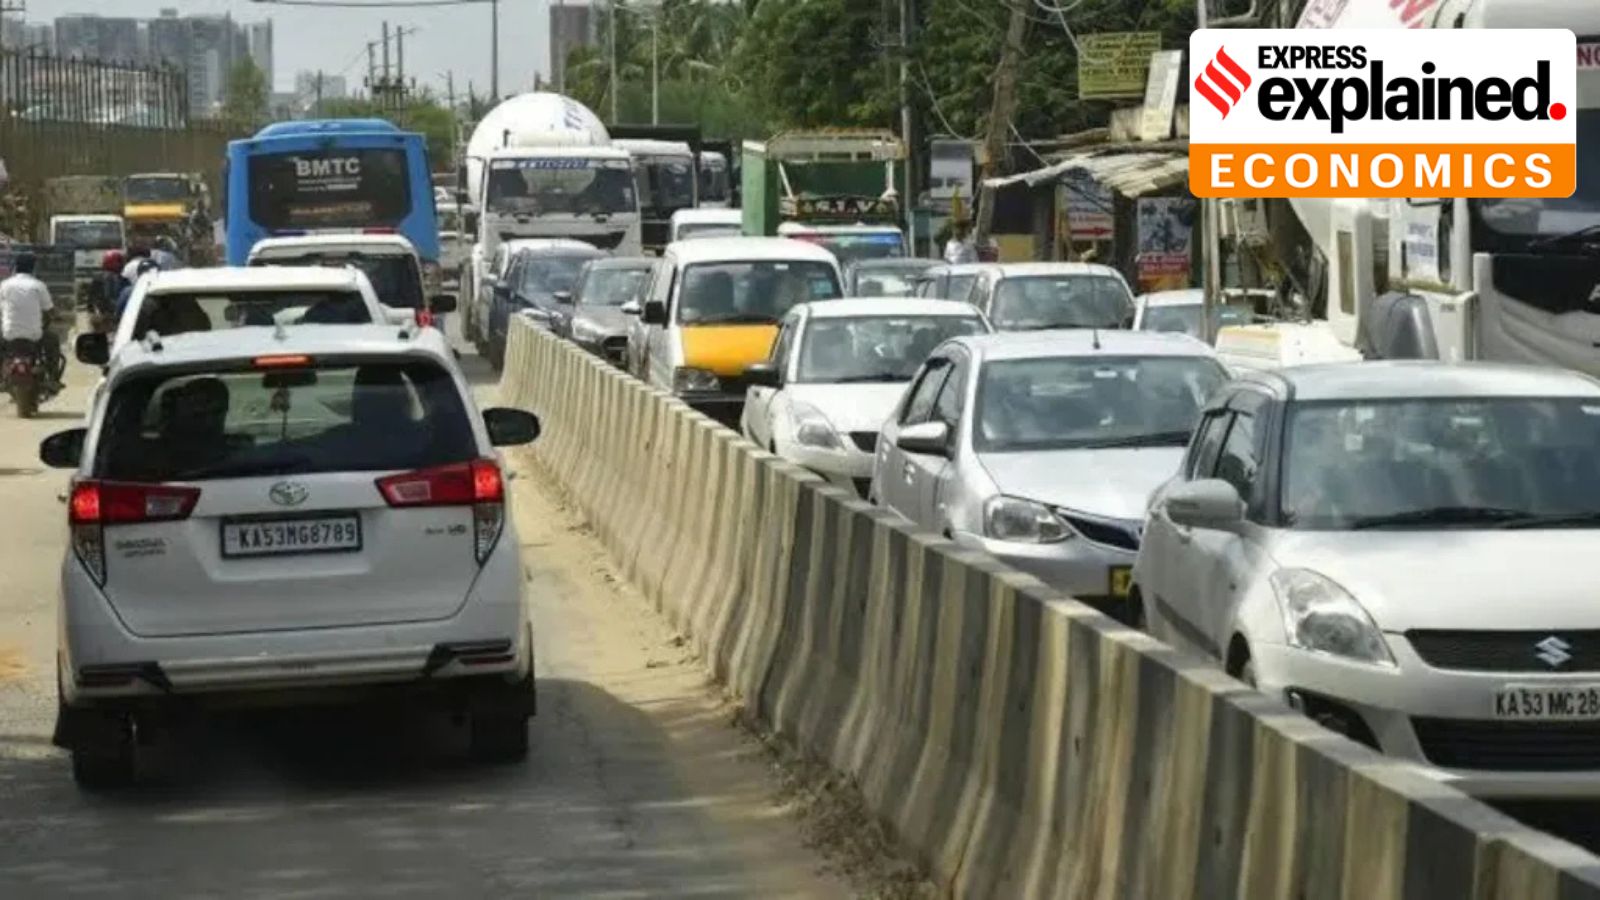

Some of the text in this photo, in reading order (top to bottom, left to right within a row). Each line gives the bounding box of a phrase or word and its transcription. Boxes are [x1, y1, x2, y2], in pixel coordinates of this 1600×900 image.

[296, 158, 361, 176] BMTC
[238, 523, 355, 549] KA53MG8789
[1496, 692, 1519, 715] KA
[1522, 690, 1543, 715] 53
[1548, 692, 1575, 715] MC
